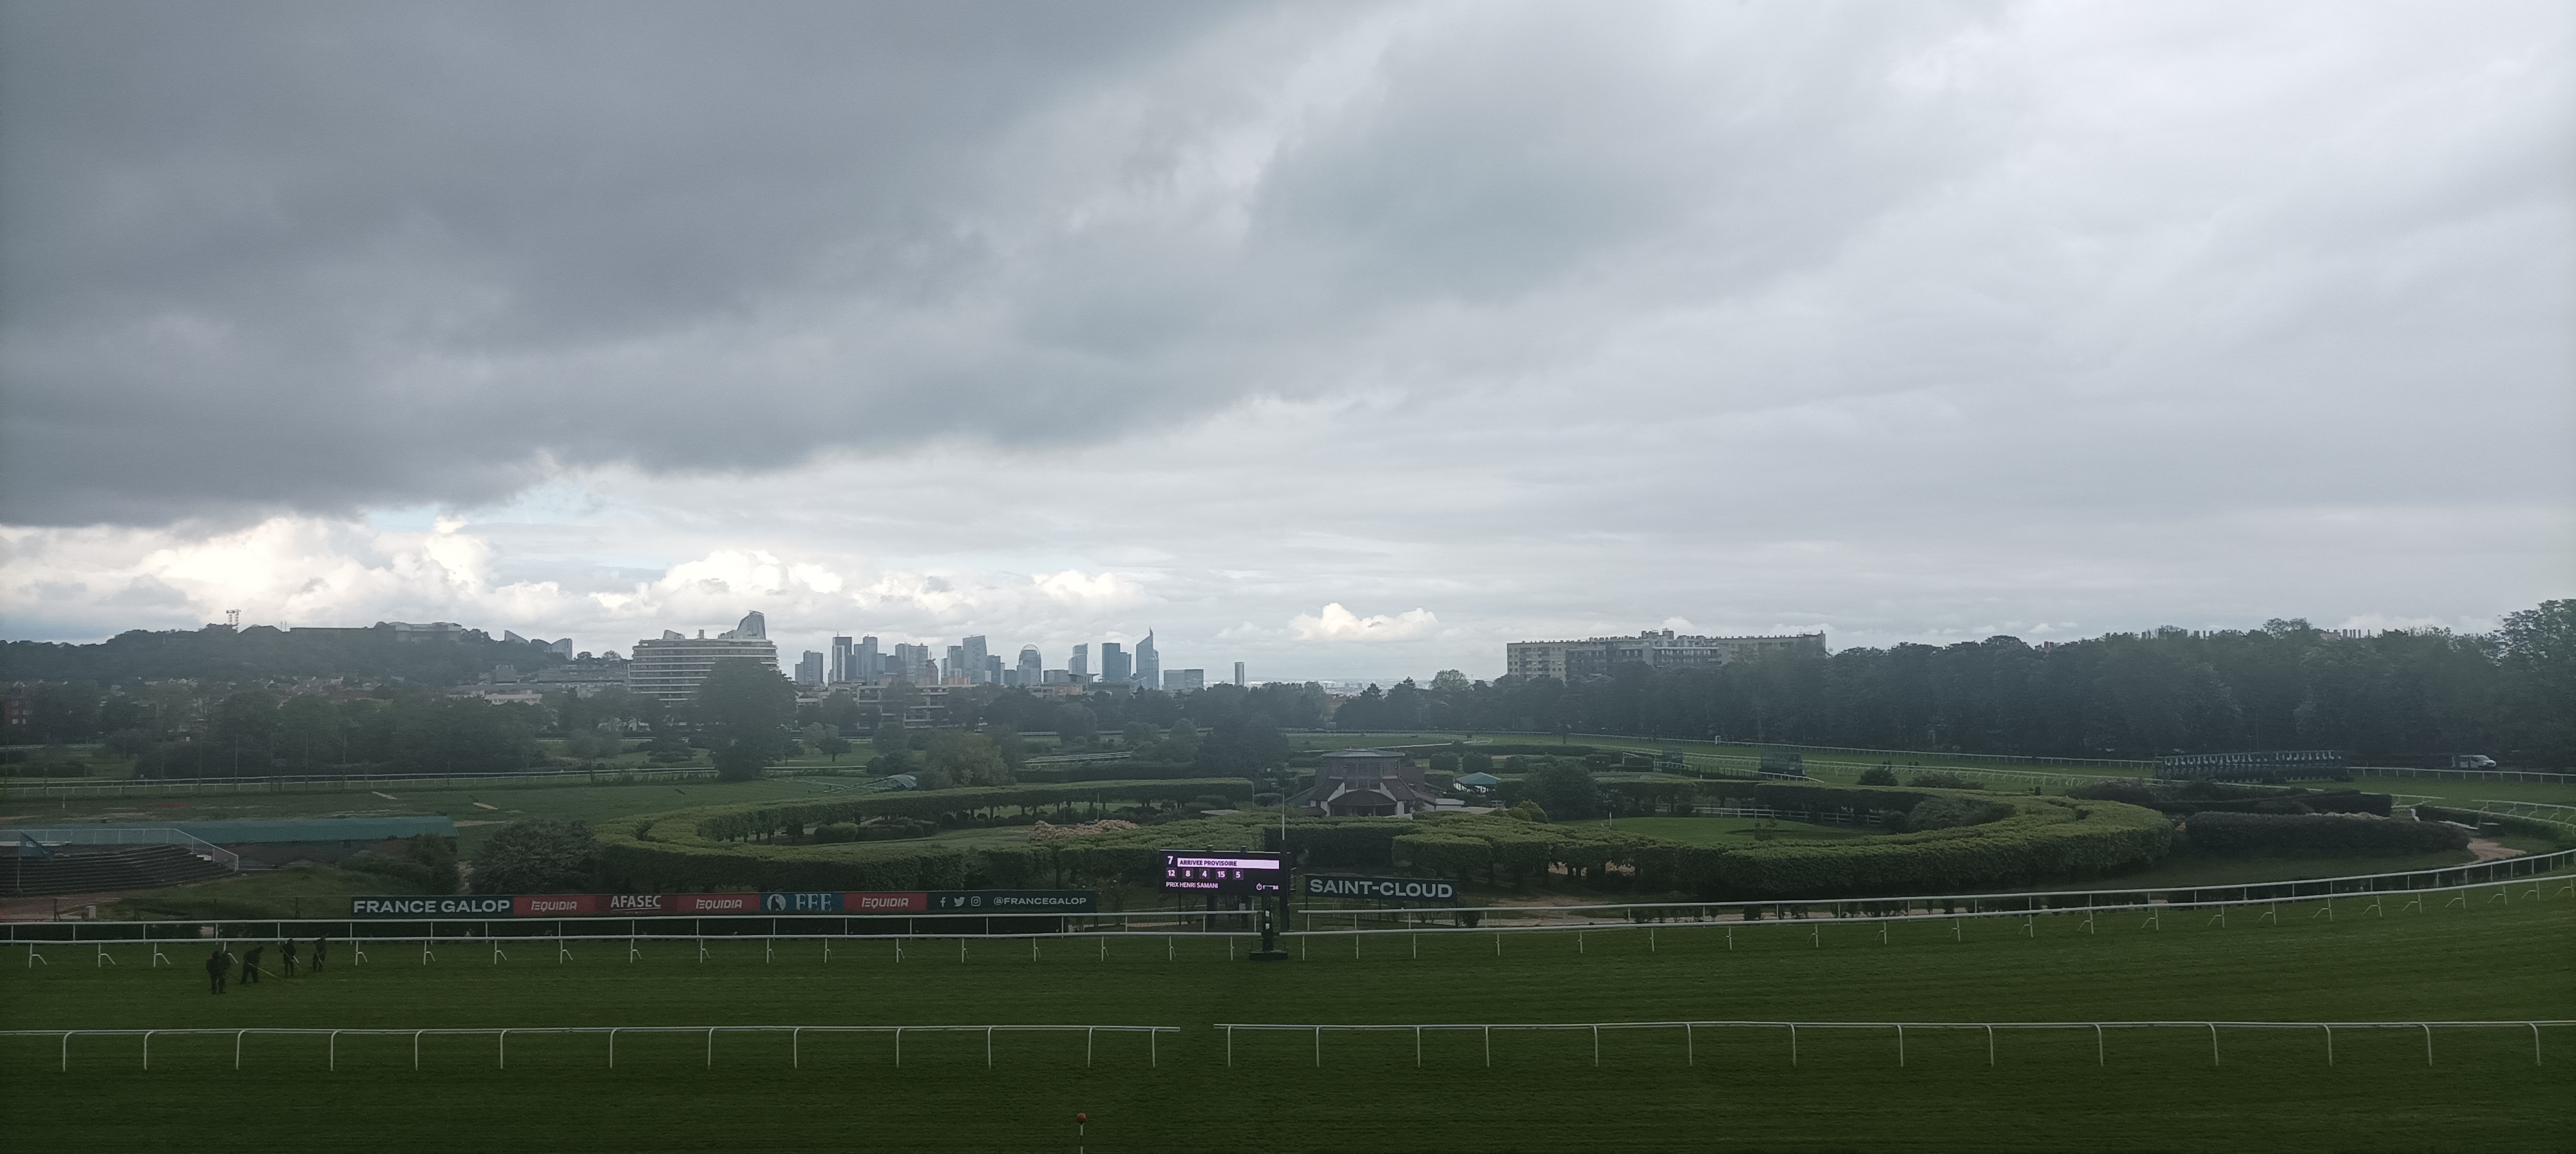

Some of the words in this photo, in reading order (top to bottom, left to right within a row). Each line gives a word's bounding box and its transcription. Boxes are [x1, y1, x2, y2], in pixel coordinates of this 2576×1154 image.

[1167, 855, 1173, 865] 7
[1310, 878, 1453, 898] SAINT-CLOUD
[354, 900, 437, 913] FRANCE
[440, 900, 511, 913] GALOP
[531, 900, 578, 912] EQUIDIA
[611, 895, 661, 908] AFASEC
[696, 898, 743, 911] EQUIDIA
[794, 893, 832, 912] FEE
[862, 896, 909, 909] EQUIDIA
[993, 896, 1087, 905] @FRANCEGALOP
